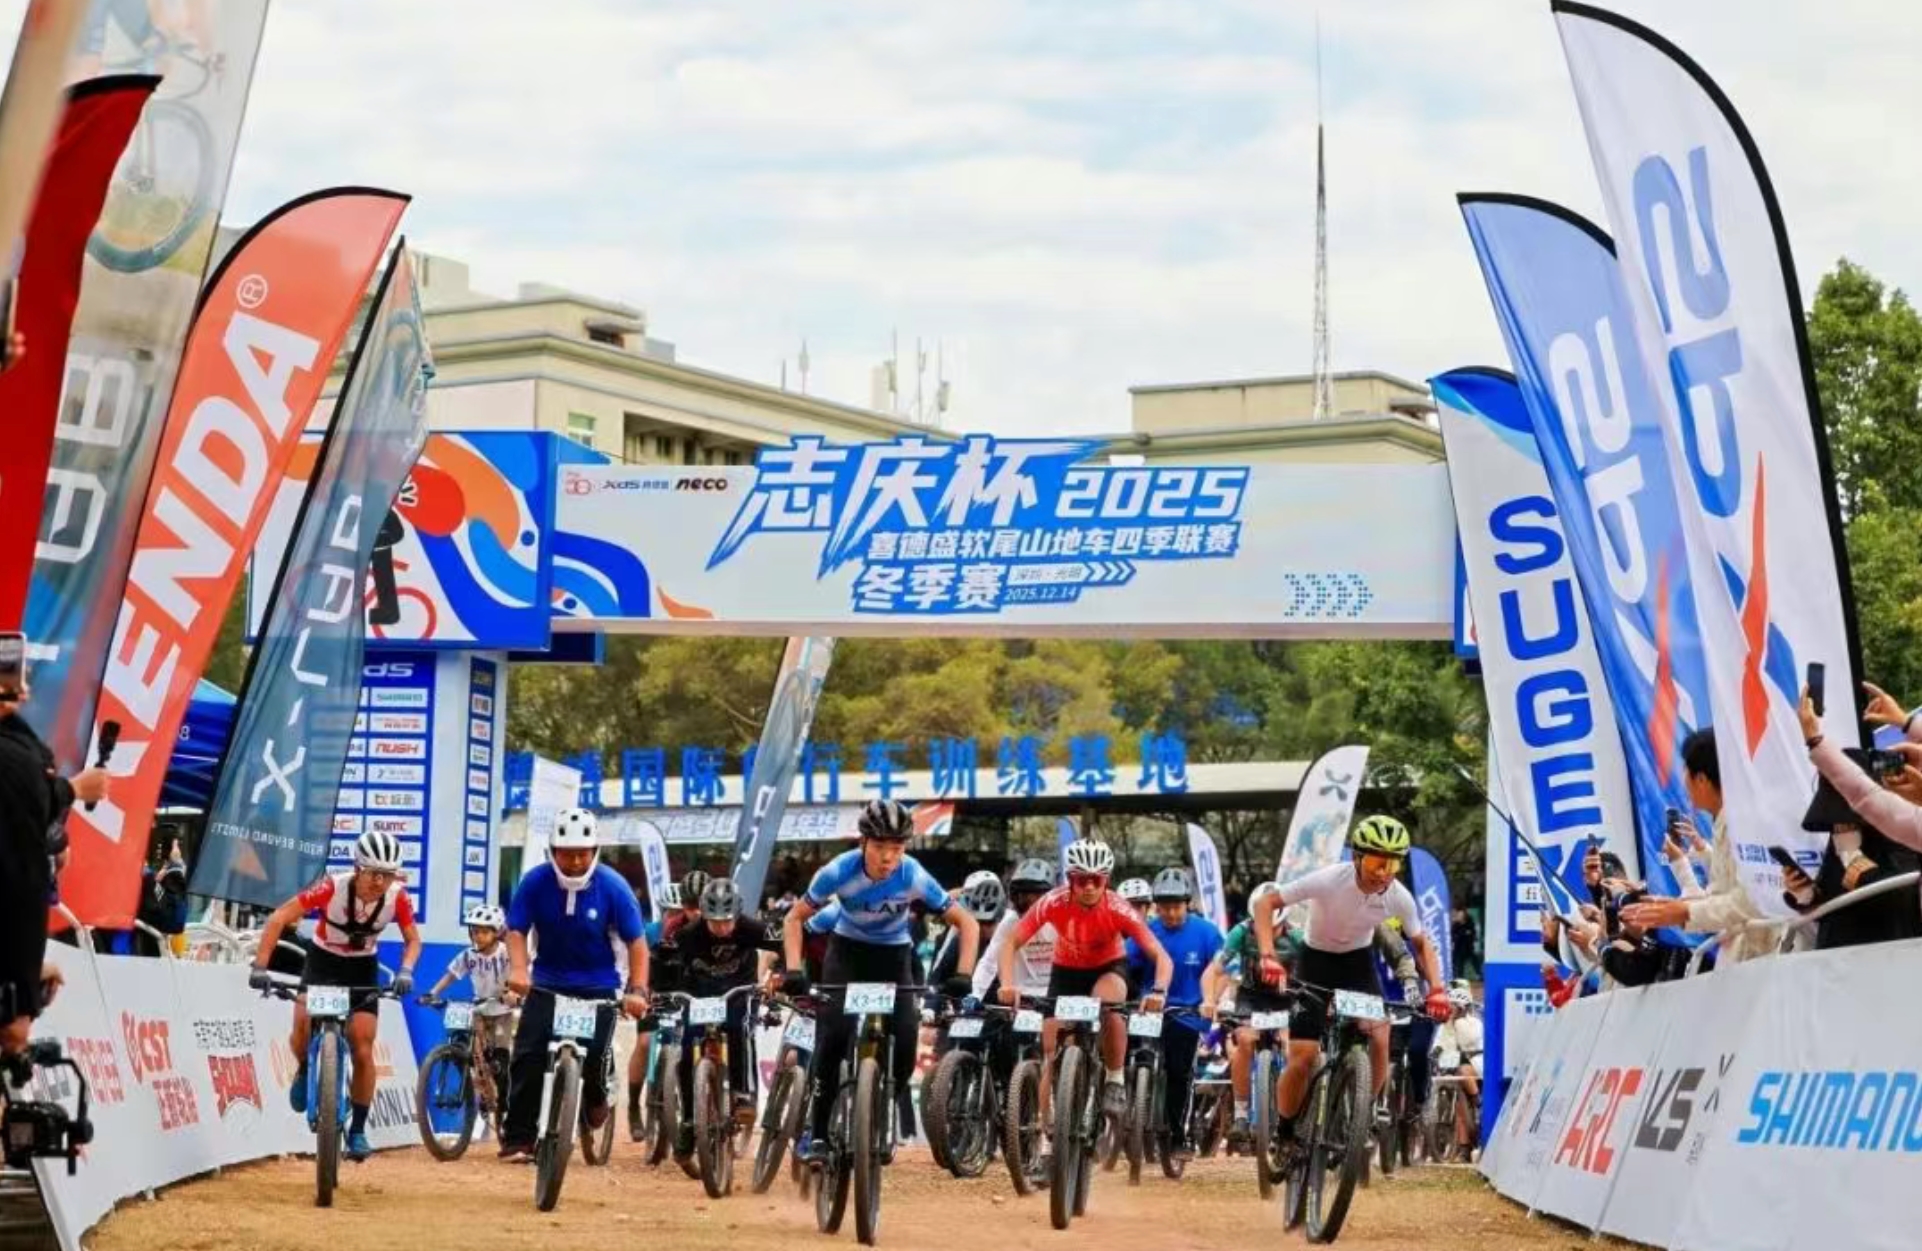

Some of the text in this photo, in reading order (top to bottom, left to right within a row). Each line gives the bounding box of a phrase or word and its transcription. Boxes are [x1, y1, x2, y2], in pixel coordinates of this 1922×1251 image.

[675, 477, 728, 491] neco
[712, 437, 1248, 565] 志庆杯 2025
[868, 523, 1237, 561] 喜德盛软尾山地车四季联赛
[856, 563, 1003, 609] 冬季赛
[1004, 585, 1077, 600] 2025.12.14
[137, 1020, 172, 1073] CST
[1554, 1068, 1644, 1175] ARC
